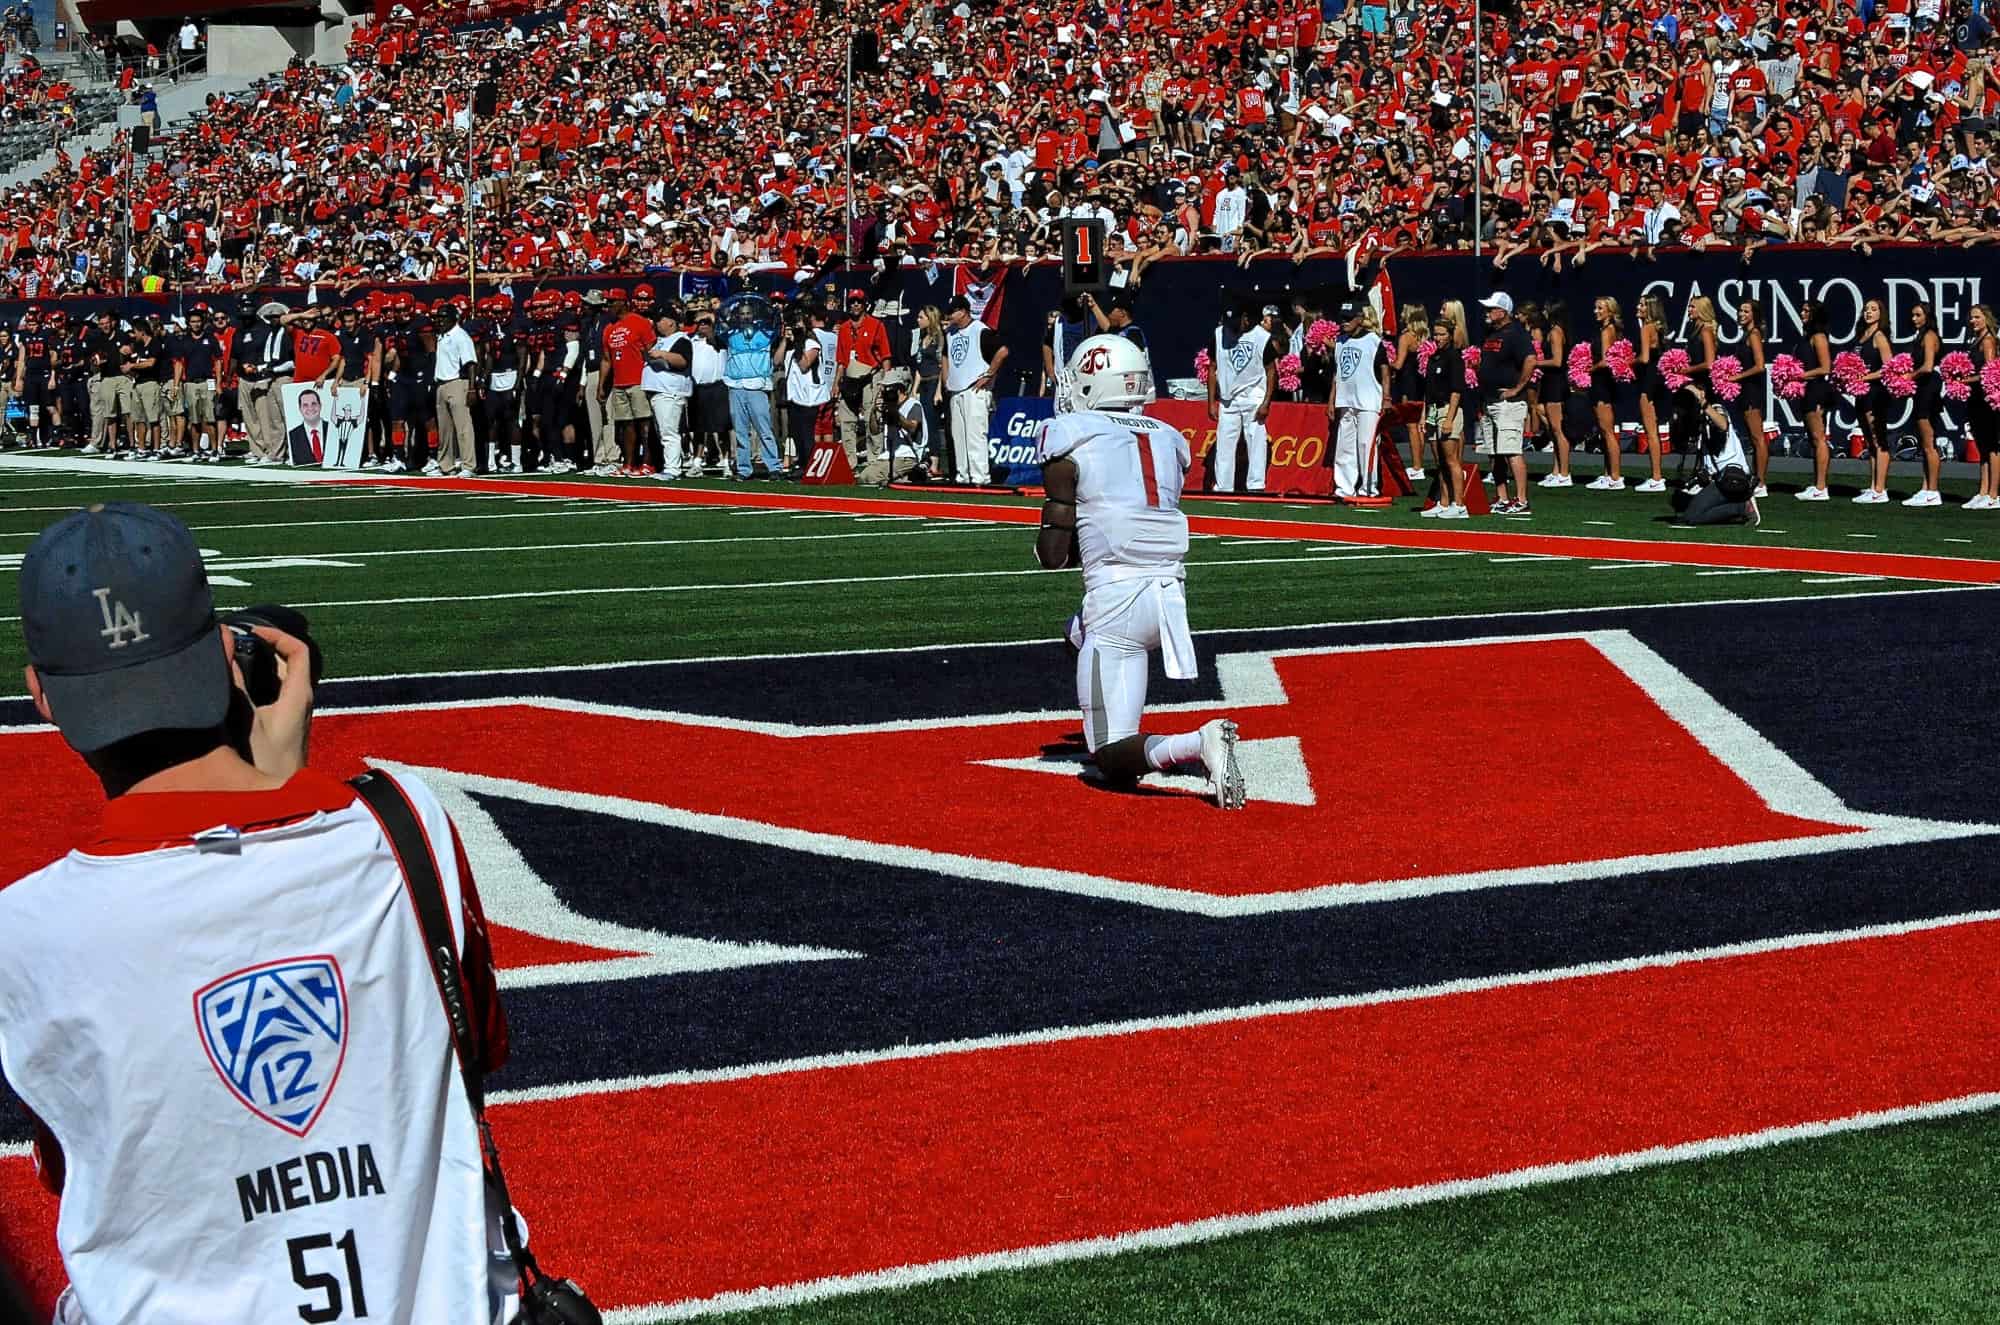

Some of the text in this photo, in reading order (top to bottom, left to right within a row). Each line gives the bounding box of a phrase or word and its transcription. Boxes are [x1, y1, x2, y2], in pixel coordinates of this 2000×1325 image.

[1076, 226, 1091, 264] 1
[806, 448, 834, 478] 20
[1130, 430, 1160, 508] 1
[92, 588, 150, 648] LA
[202, 964, 340, 1084] PAC
[262, 1051, 319, 1105] 12
[235, 1143, 385, 1223] MEDIA
[286, 1229, 368, 1325] 51
